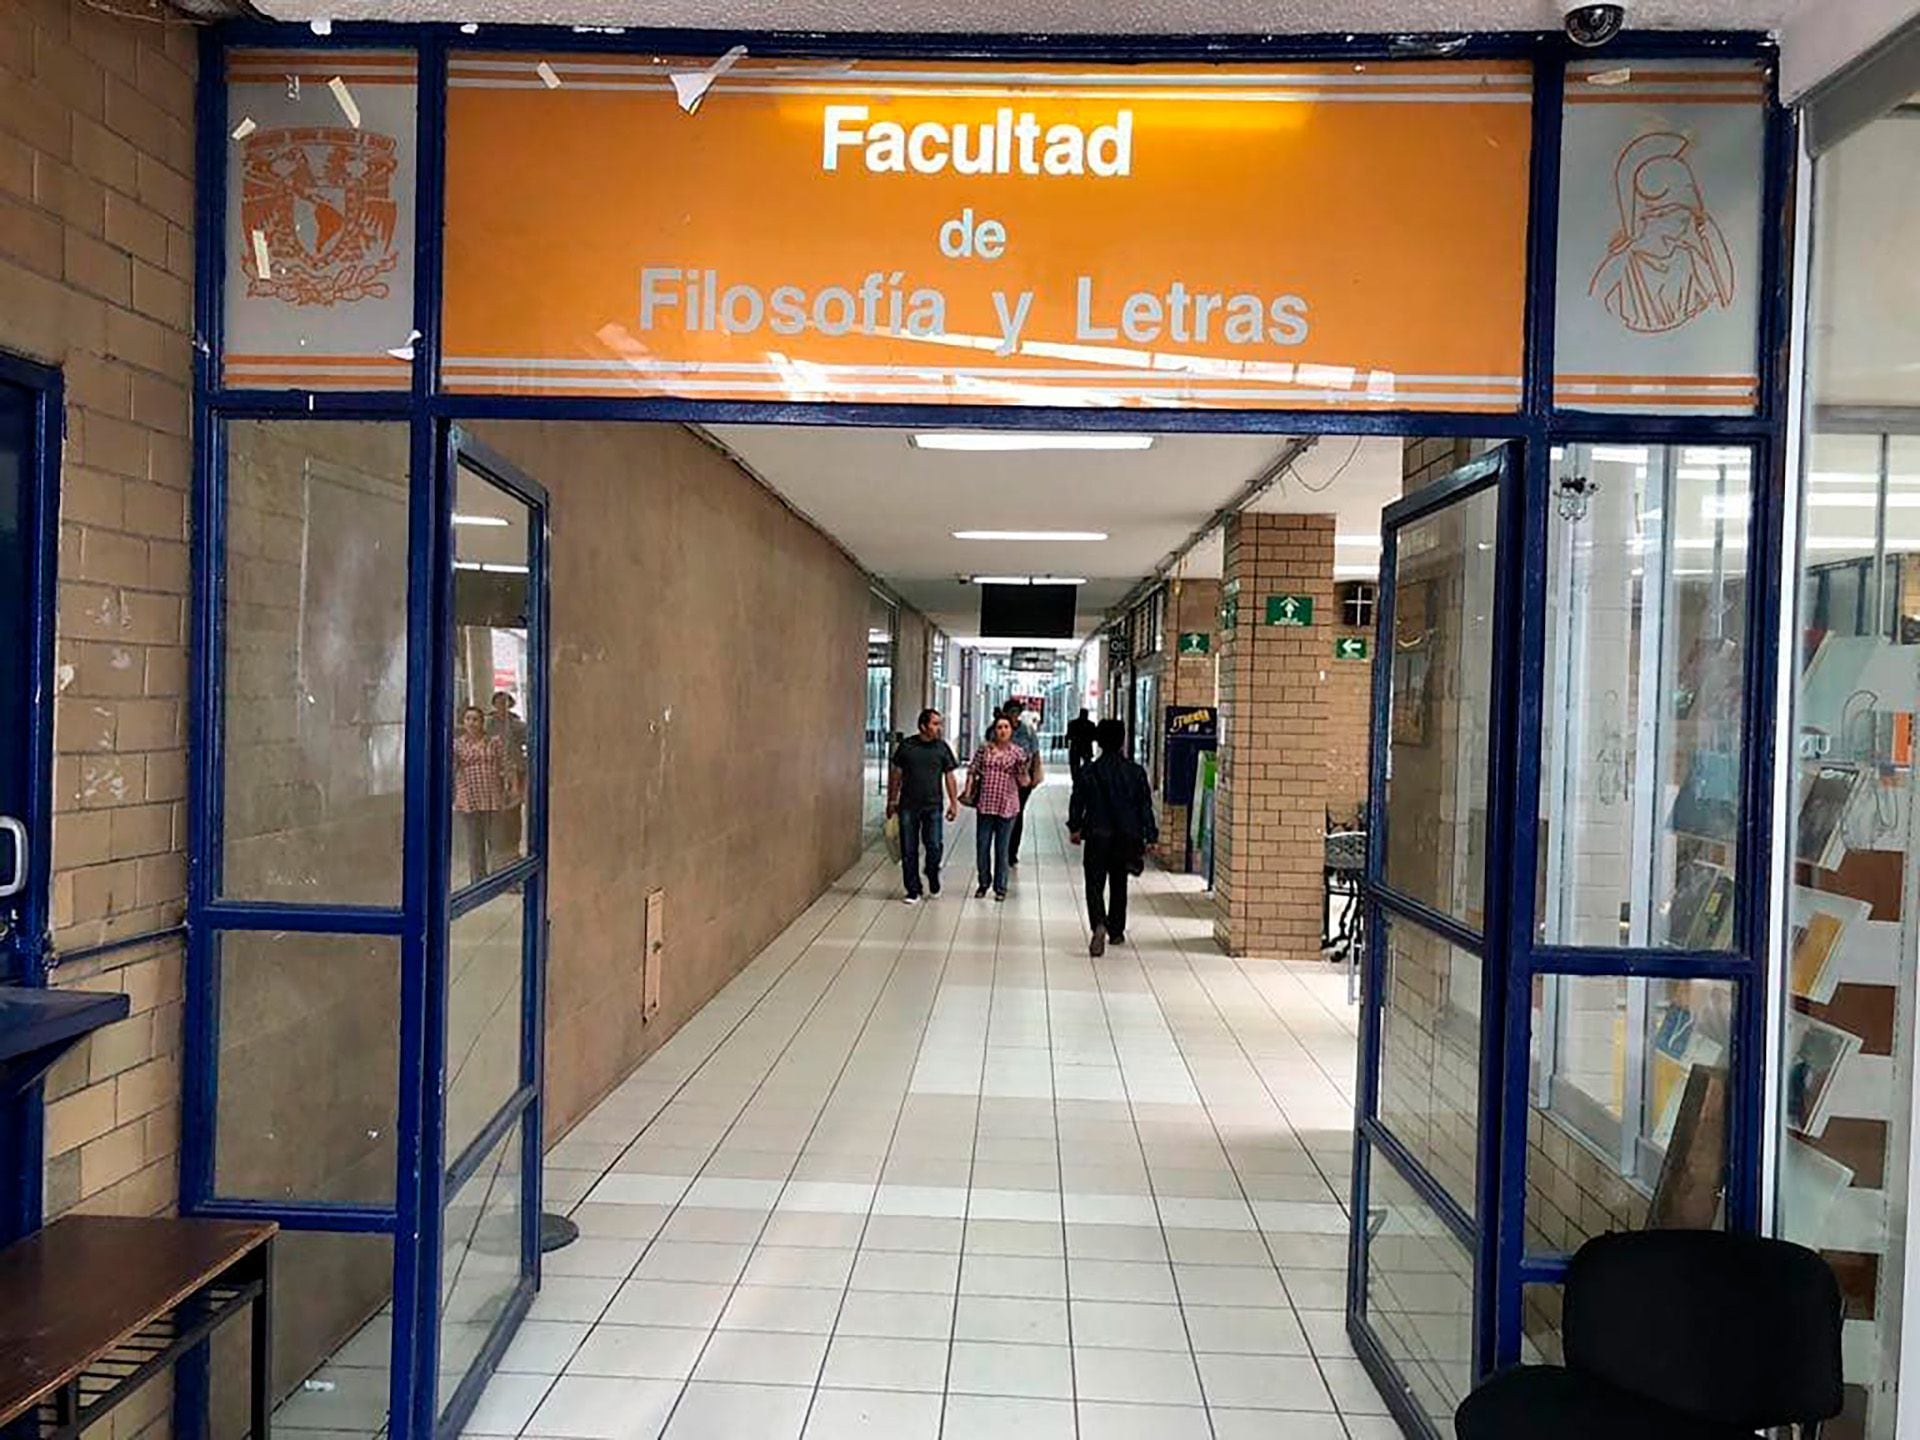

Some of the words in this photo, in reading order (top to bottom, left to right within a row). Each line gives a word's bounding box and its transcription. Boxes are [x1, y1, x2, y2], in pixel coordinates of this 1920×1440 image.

[822, 104, 1134, 177] Facultad
[938, 207, 1007, 259] de
[638, 267, 947, 337] Filosofía
[992, 289, 1034, 357] y
[1075, 276, 1310, 346] Letras
